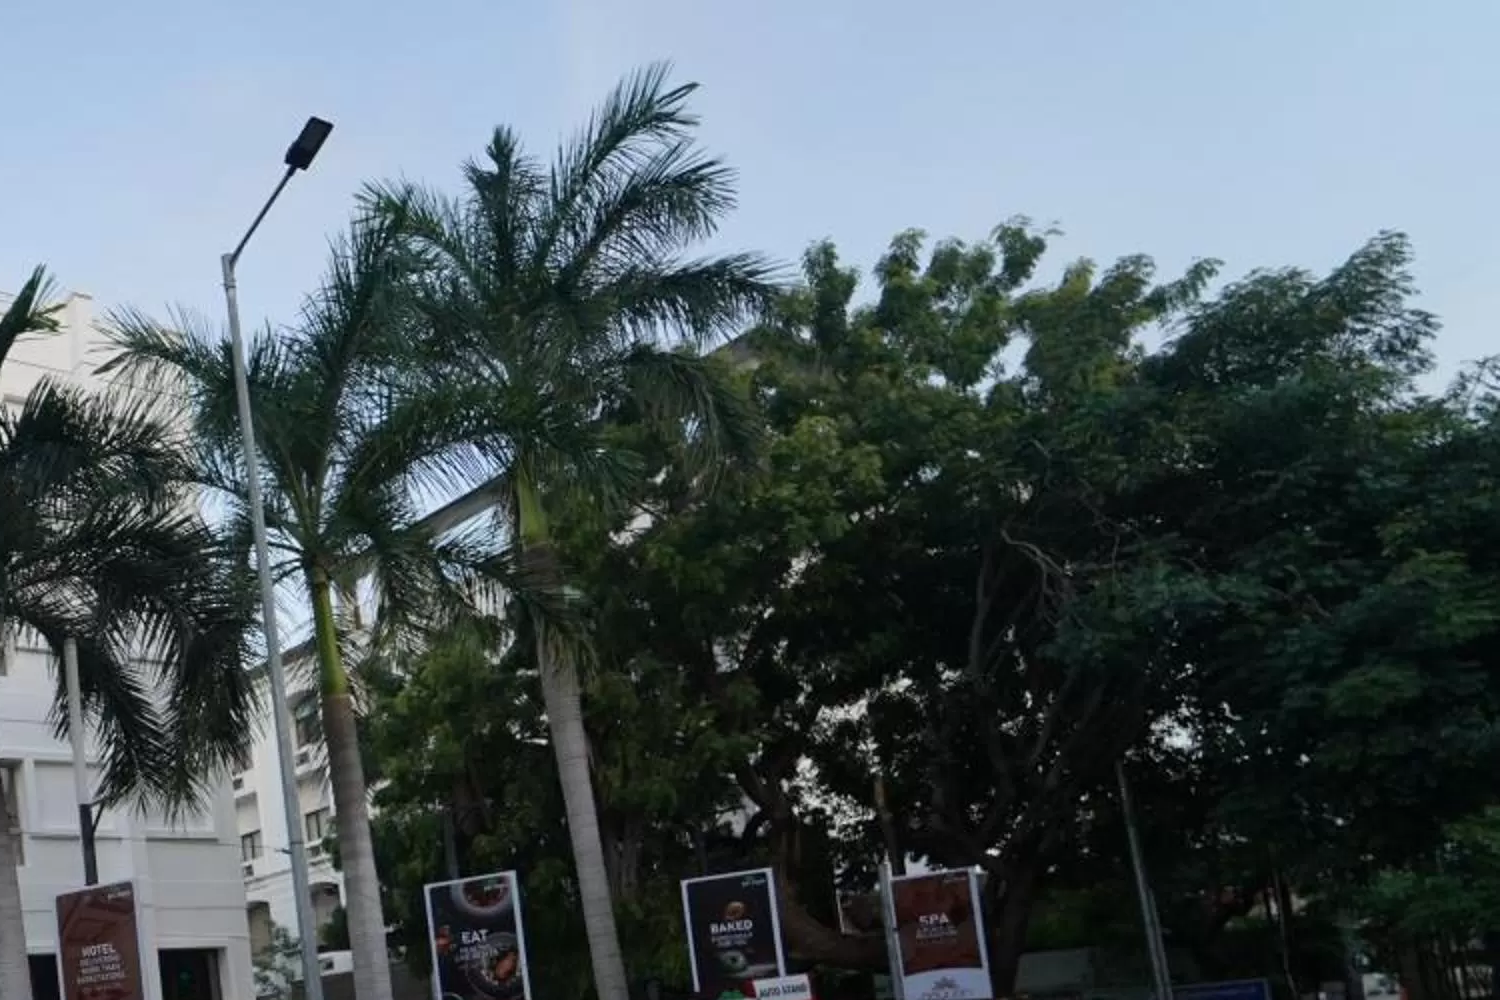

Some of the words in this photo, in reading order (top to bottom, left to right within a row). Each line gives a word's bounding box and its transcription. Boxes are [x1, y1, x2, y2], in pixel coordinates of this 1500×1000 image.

[919, 912, 949, 925] SPA
[709, 919, 753, 934] BAKED
[461, 929, 488, 944] EAT
[81, 944, 116, 957] HOTEL
